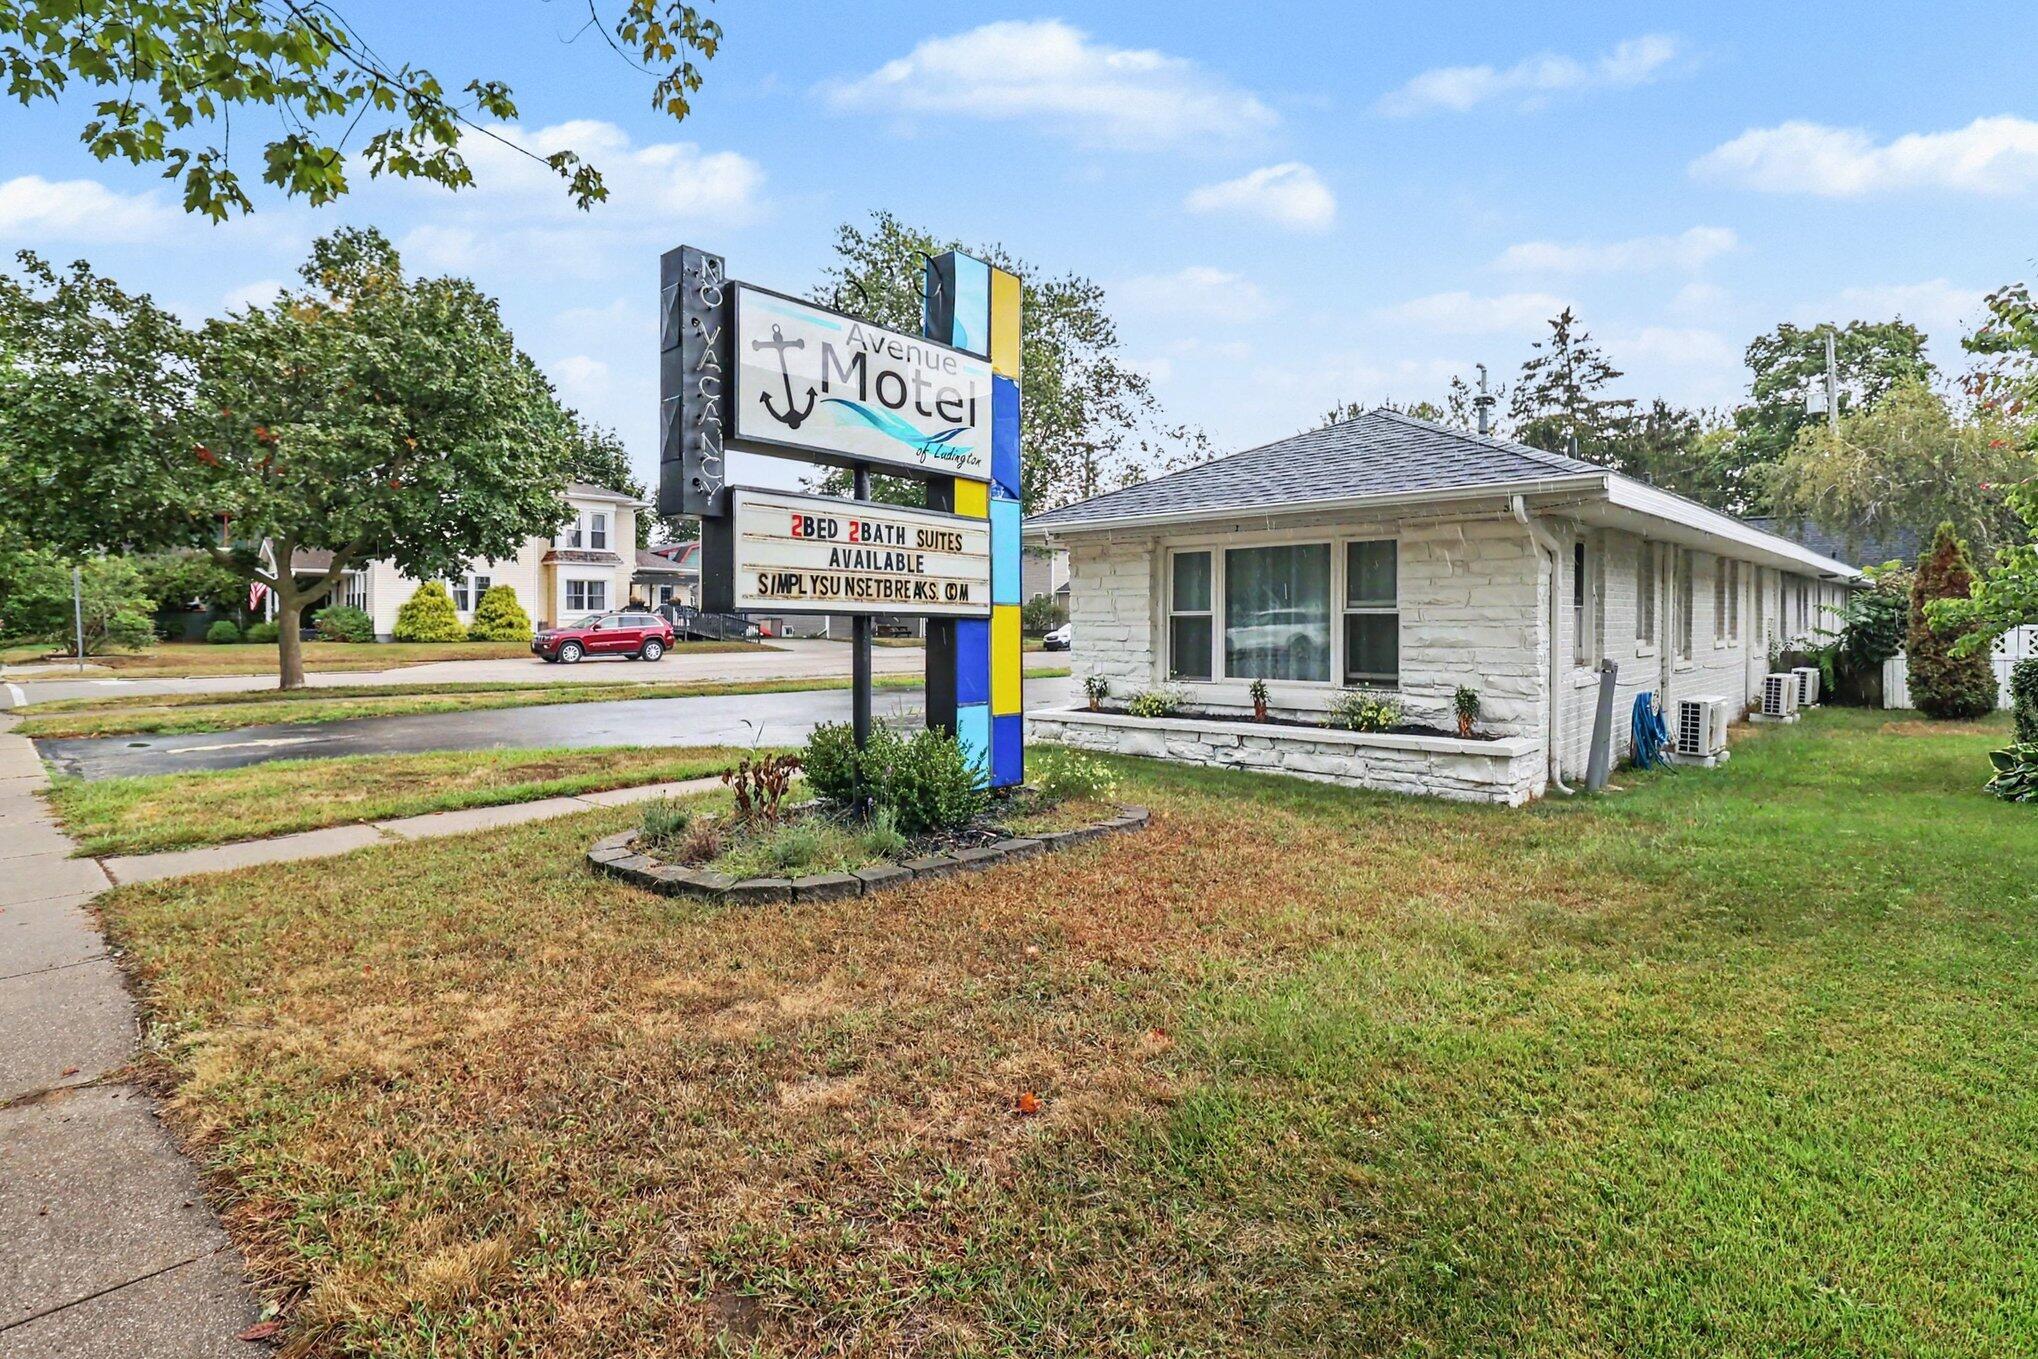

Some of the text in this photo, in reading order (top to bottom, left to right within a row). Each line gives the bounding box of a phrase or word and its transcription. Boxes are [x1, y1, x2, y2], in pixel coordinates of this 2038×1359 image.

[846, 322, 958, 376] Avenue
[698, 255, 723, 506] NO VACANCY
[821, 341, 976, 428] Motel
[916, 442, 983, 469] of Ludington
[791, 514, 963, 552] 2BED 2BATH SUITES
[829, 547, 925, 574] AVAILABLE
